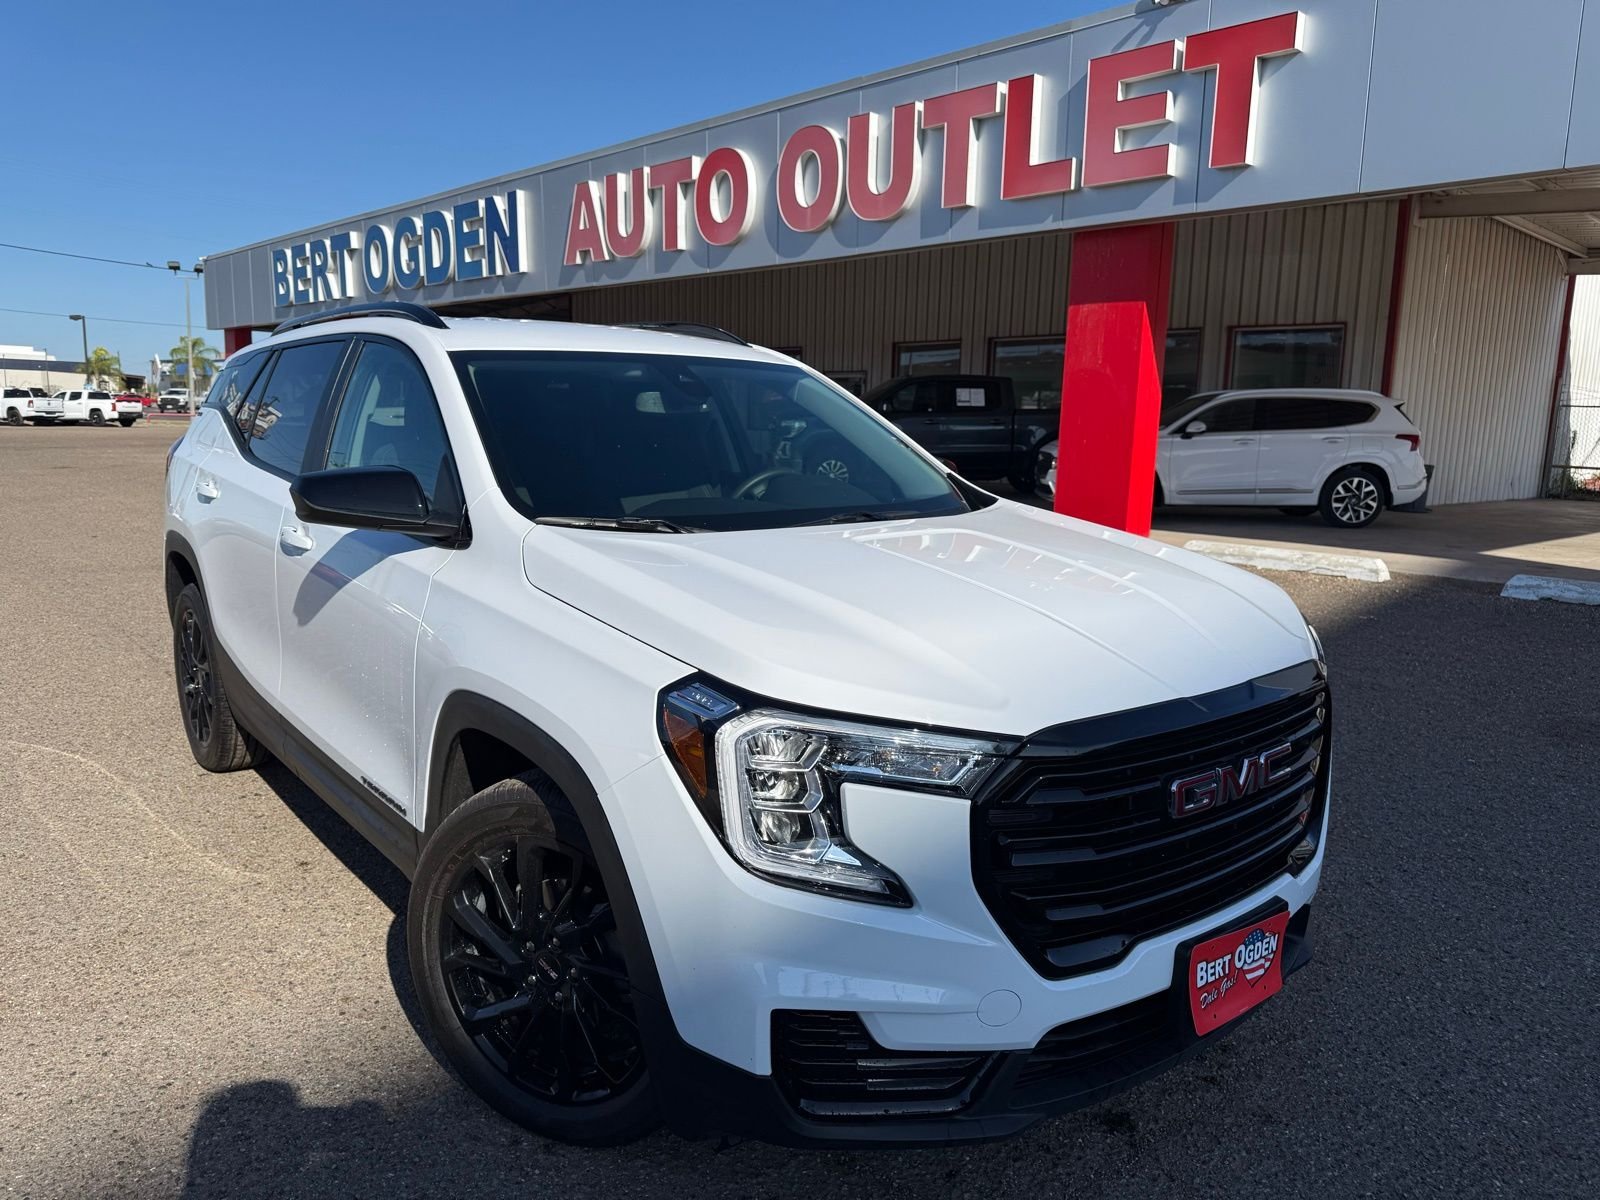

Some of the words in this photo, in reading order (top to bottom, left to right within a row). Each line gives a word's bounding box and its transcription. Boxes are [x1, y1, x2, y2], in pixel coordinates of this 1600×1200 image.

[273, 231, 358, 307] BERT
[362, 189, 528, 295] OGDEN
[564, 147, 758, 266] AUTO
[776, 10, 1304, 233] OUTLET
[1170, 742, 1293, 819] GMC
[1196, 953, 1232, 988] BERT
[1234, 933, 1278, 969] OGDEN
